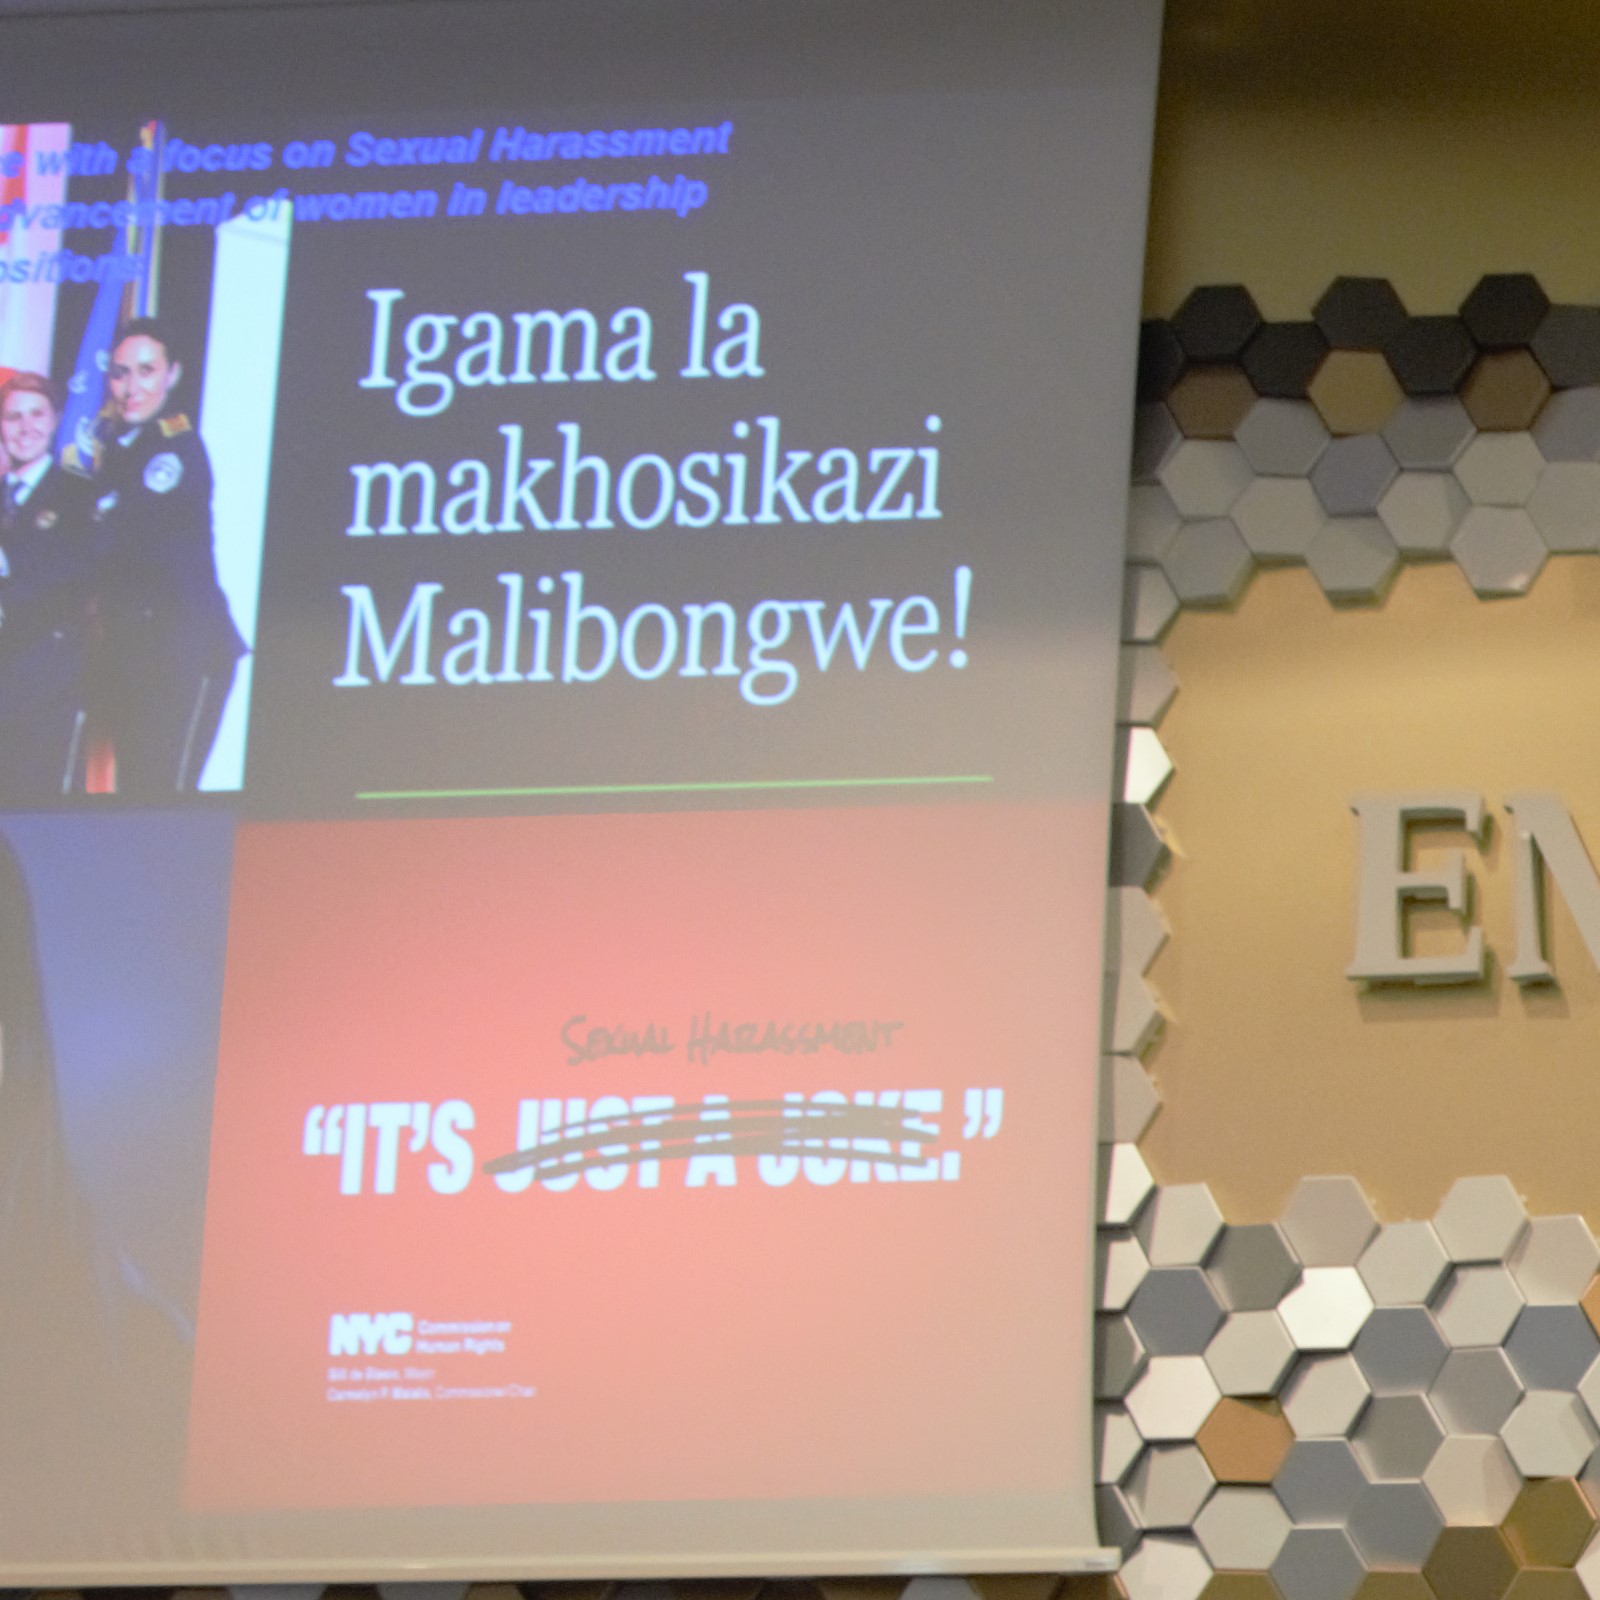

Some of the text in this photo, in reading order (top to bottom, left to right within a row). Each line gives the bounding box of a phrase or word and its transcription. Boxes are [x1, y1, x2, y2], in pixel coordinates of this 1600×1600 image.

[36, 141, 118, 177] with
[162, 137, 274, 173] focus
[282, 140, 336, 169] on
[345, 127, 484, 167] Sexual
[488, 121, 733, 162] Harassment
[244, 187, 290, 222] of
[294, 189, 439, 221] women
[447, 182, 487, 216] in
[495, 174, 708, 218] leadership
[359, 271, 765, 416] Igama la
[345, 415, 942, 537] makhosikazi
[333, 565, 972, 706] Malibongwe!
[494, 1096, 675, 1192] JUST
[685, 1095, 738, 1188] A
[329, 1312, 413, 1356] NYC
